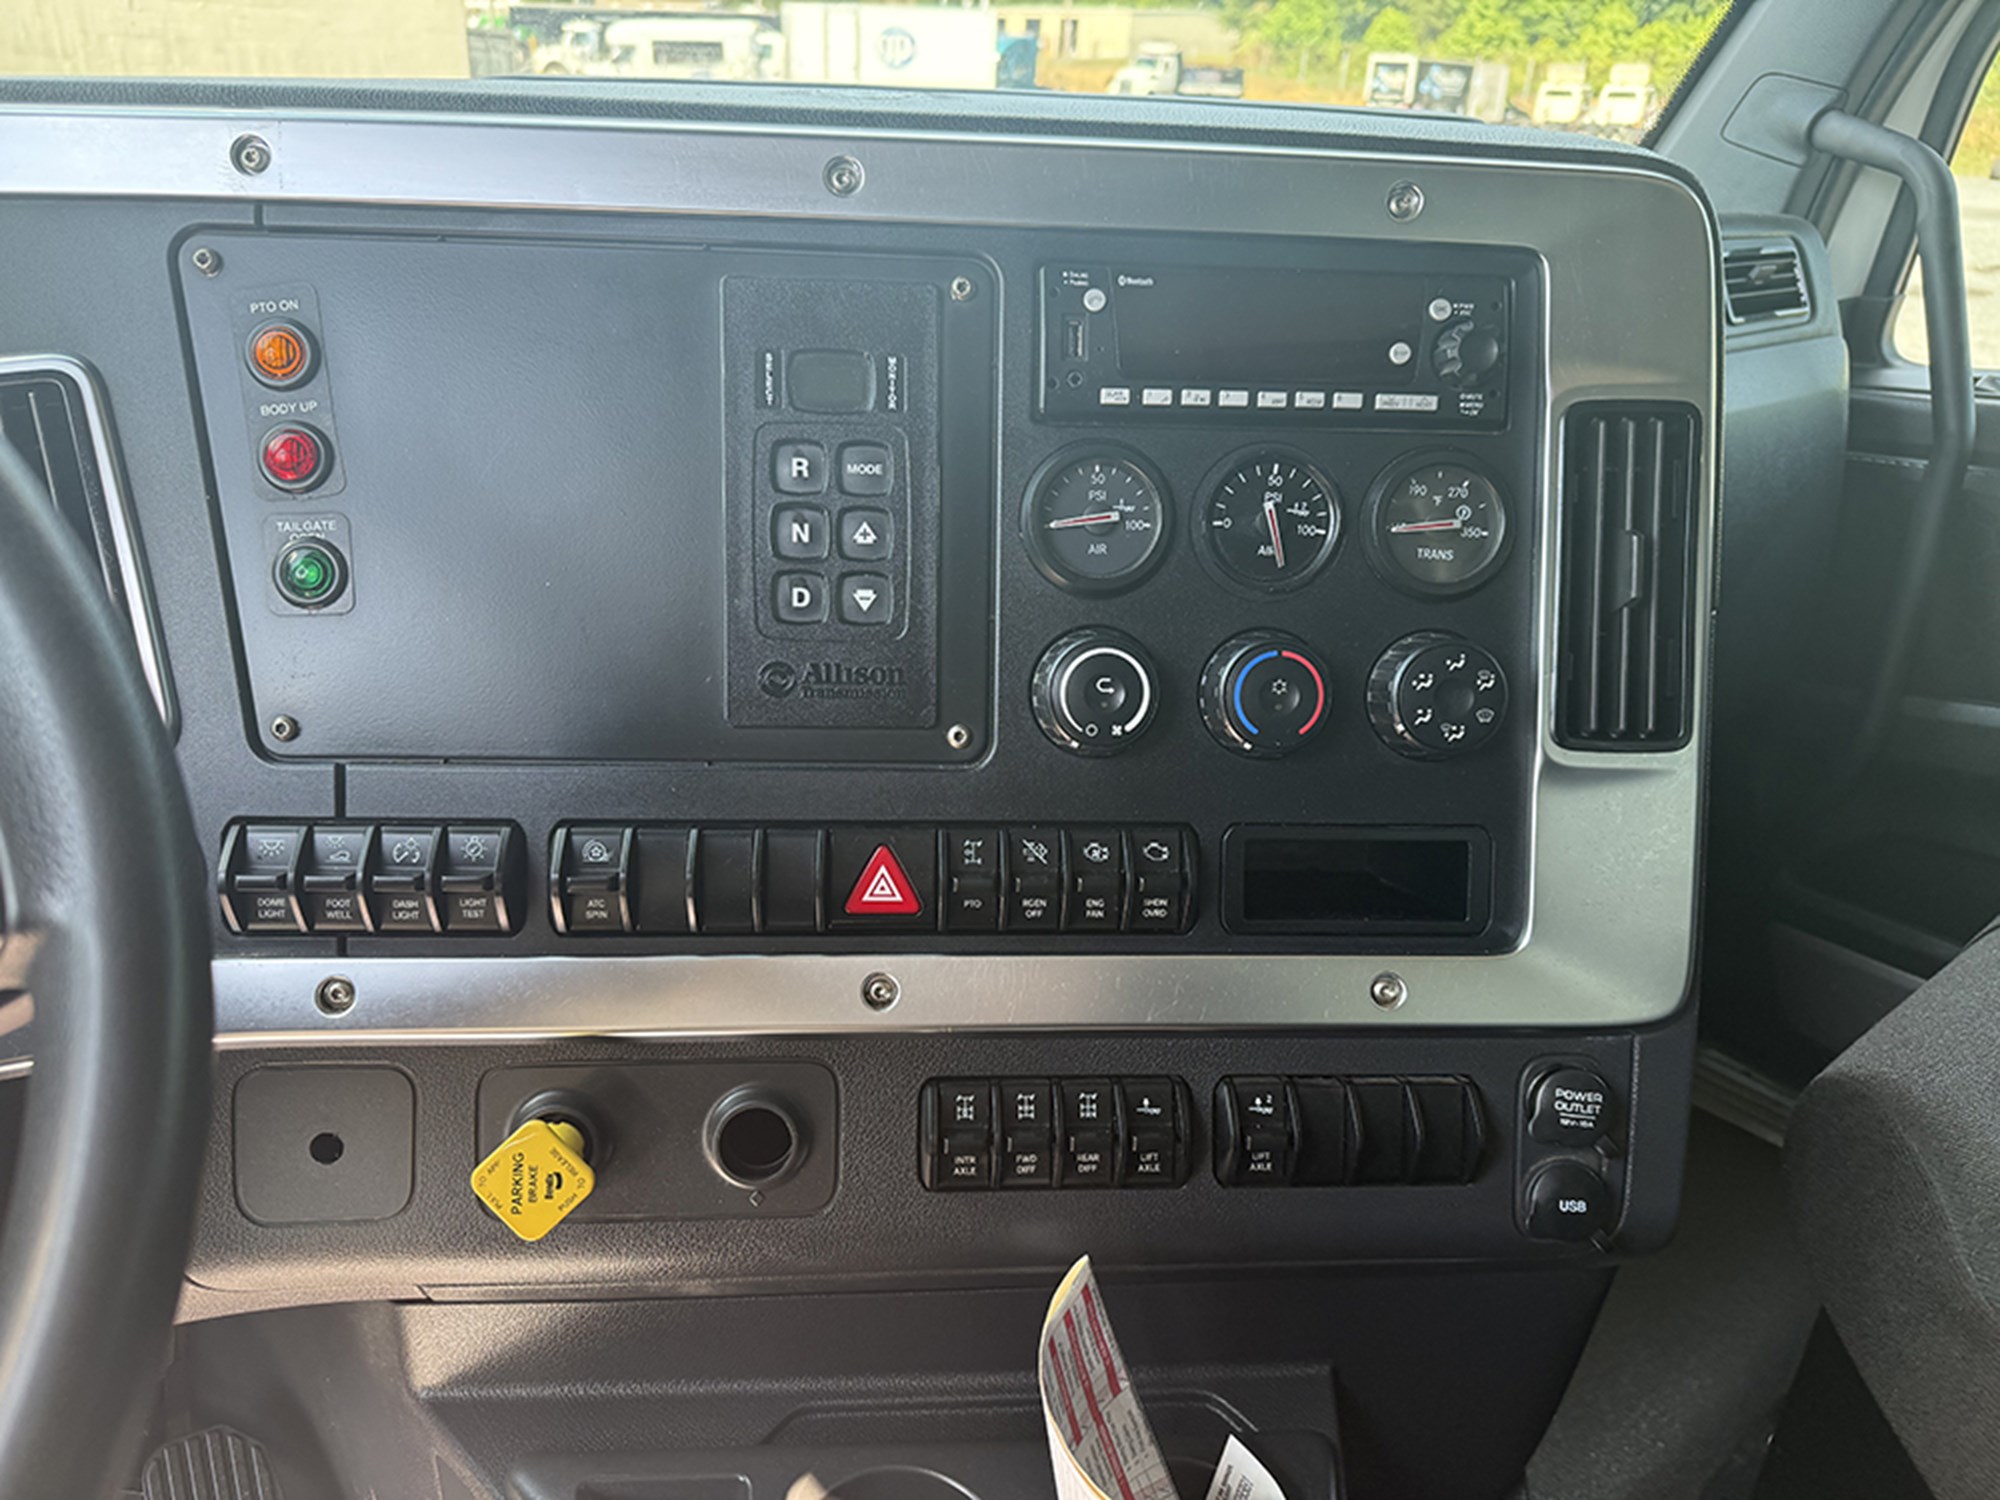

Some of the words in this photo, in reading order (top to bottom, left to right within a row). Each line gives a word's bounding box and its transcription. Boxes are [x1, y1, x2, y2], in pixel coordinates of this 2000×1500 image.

[249, 301, 277, 314] PTO
[279, 299, 299, 312] ON
[888, 356, 897, 410] MONITOR
[260, 402, 297, 416] BODY
[299, 400, 317, 413] UP
[792, 457, 809, 478] R
[847, 463, 883, 475] MODE
[1091, 473, 1106, 485] 50
[1267, 474, 1283, 487] 50
[1088, 490, 1107, 501] PSI
[1264, 491, 1282, 503] PSI
[1447, 486, 1469, 499] 270
[276, 520, 337, 532] TAILGATE
[1125, 519, 1144, 531] 100
[1223, 517, 1232, 529] 0
[792, 523, 810, 543] N
[1297, 524, 1316, 536] 100
[1460, 526, 1481, 538] 350
[1087, 543, 1108, 555] AIR
[1417, 547, 1454, 561] TRANS
[792, 587, 811, 608] D
[257, 897, 286, 908] DOME
[325, 899, 351, 909] FOOT
[392, 899, 419, 909] DASH
[459, 898, 487, 908] LIGHT
[587, 899, 605, 909] ATC
[963, 899, 982, 908] PTO
[1086, 899, 1105, 908] ENG
[258, 909, 286, 919] LIGHT
[325, 910, 353, 920] WELL
[392, 910, 420, 920] LIGHT
[462, 909, 484, 919] TEST
[585, 910, 608, 920] SPIN
[1024, 909, 1043, 919] OFF
[1085, 909, 1104, 919] FAN
[1555, 1088, 1603, 1103] POWER
[1553, 1100, 1601, 1115] OUTLET
[954, 1156, 976, 1165] INTR
[1016, 1154, 1038, 1163] FWD
[1077, 1154, 1100, 1162] REAR
[1140, 1153, 1159, 1162] LIFT
[1251, 1151, 1271, 1161] LIFT
[953, 1165, 977, 1175] AXLE
[1016, 1164, 1036, 1174] DIFF
[1077, 1164, 1097, 1173] DIFF
[1137, 1164, 1161, 1173] AXLE
[1249, 1162, 1272, 1172] AXLE
[510, 1151, 525, 1216] PARKING
[527, 1163, 539, 1204] BRAKE
[1559, 1199, 1587, 1213] USB
